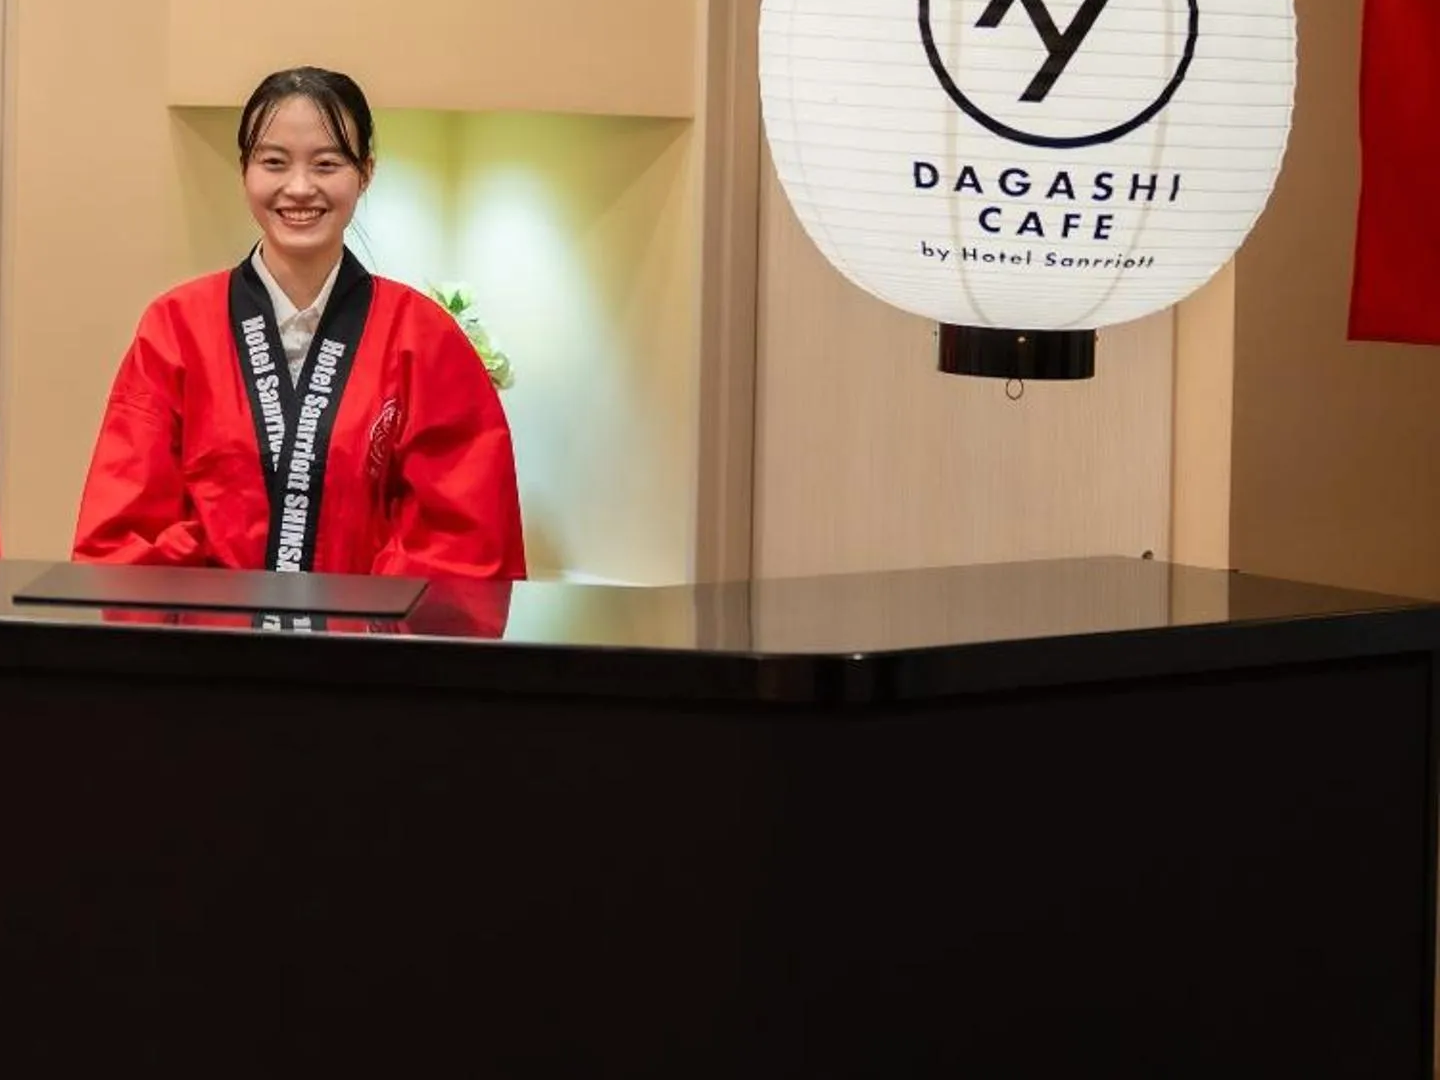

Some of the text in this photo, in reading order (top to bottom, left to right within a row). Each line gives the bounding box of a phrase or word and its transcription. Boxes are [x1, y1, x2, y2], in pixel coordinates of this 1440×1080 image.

[913, 161, 1181, 202] DAGASHI
[978, 206, 1115, 241] CAFE
[920, 240, 1155, 269] by Hotel Sanrriott
[241, 315, 276, 375] Hotel
[309, 337, 347, 394] Hotel
[287, 393, 330, 491] Sanrriott
